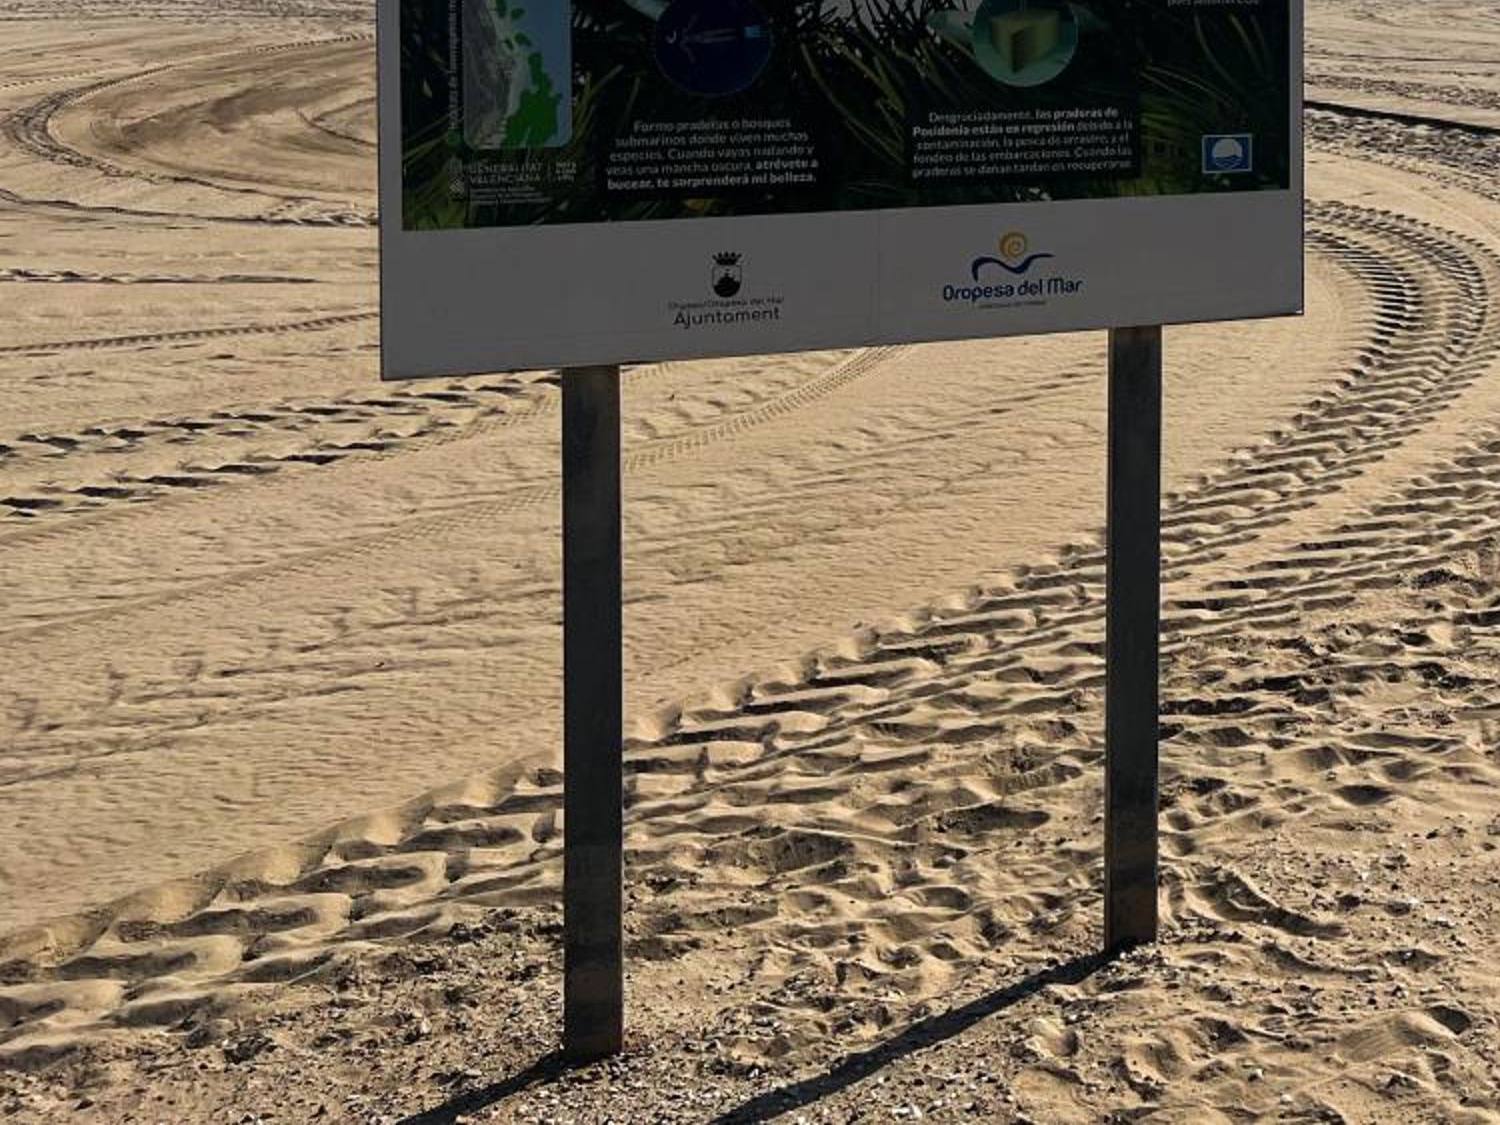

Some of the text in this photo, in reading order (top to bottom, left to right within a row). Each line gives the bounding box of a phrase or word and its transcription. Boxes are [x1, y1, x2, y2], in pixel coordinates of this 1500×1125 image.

[943, 277, 1083, 303] Oropesa del Mar
[672, 307, 780, 330] Ajuntament
